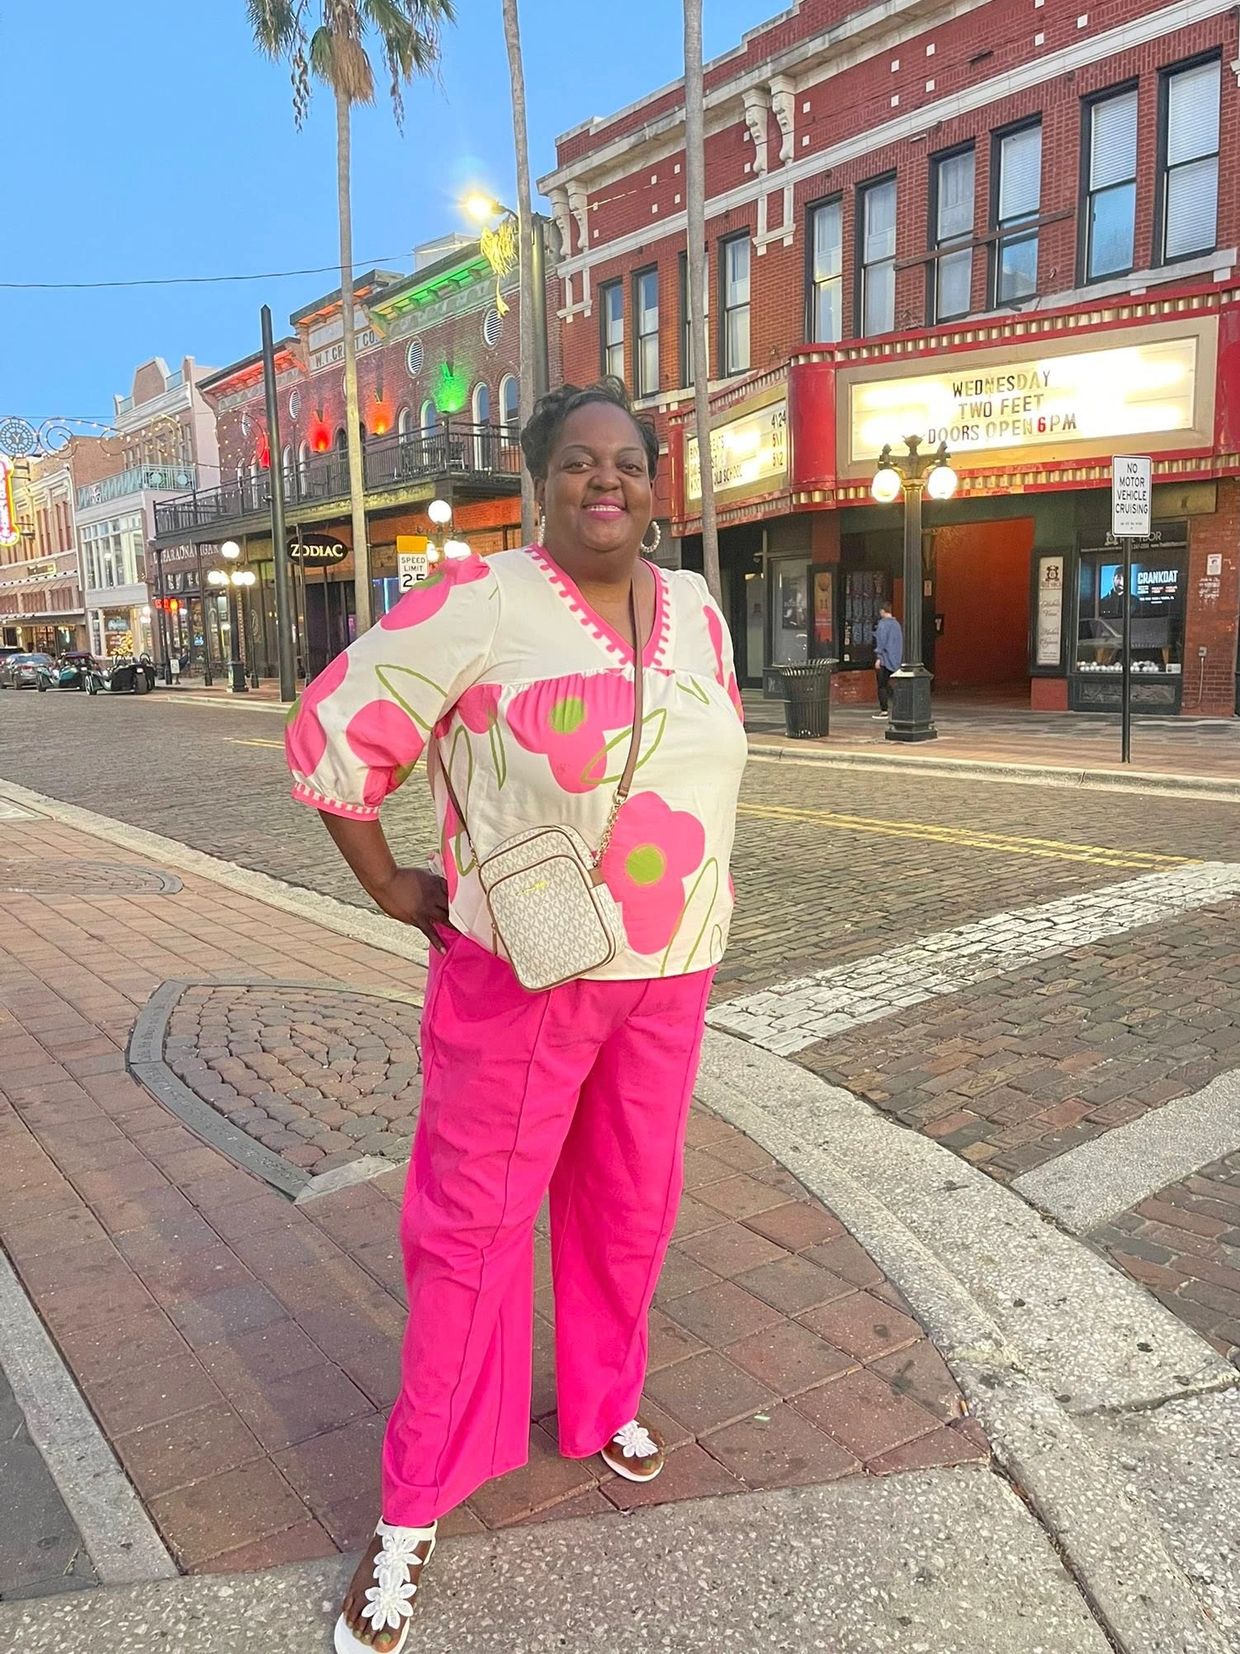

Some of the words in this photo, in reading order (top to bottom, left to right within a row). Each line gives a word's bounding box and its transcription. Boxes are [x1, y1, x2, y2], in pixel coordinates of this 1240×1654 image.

[953, 370, 1050, 398] WEDNESDAY
[958, 401, 993, 420] TWO
[1000, 394, 1045, 415] FEET
[928, 424, 980, 444] DOORS
[985, 417, 1033, 438] OPEN
[1126, 463, 1138, 474] NO
[1119, 477, 1145, 487] MOTOR
[1116, 490, 1147, 501] VEHICLE
[1115, 503, 1149, 514] CRUISING
[290, 544, 344, 557] ZODIAC
[401, 556, 426, 564] SPEED
